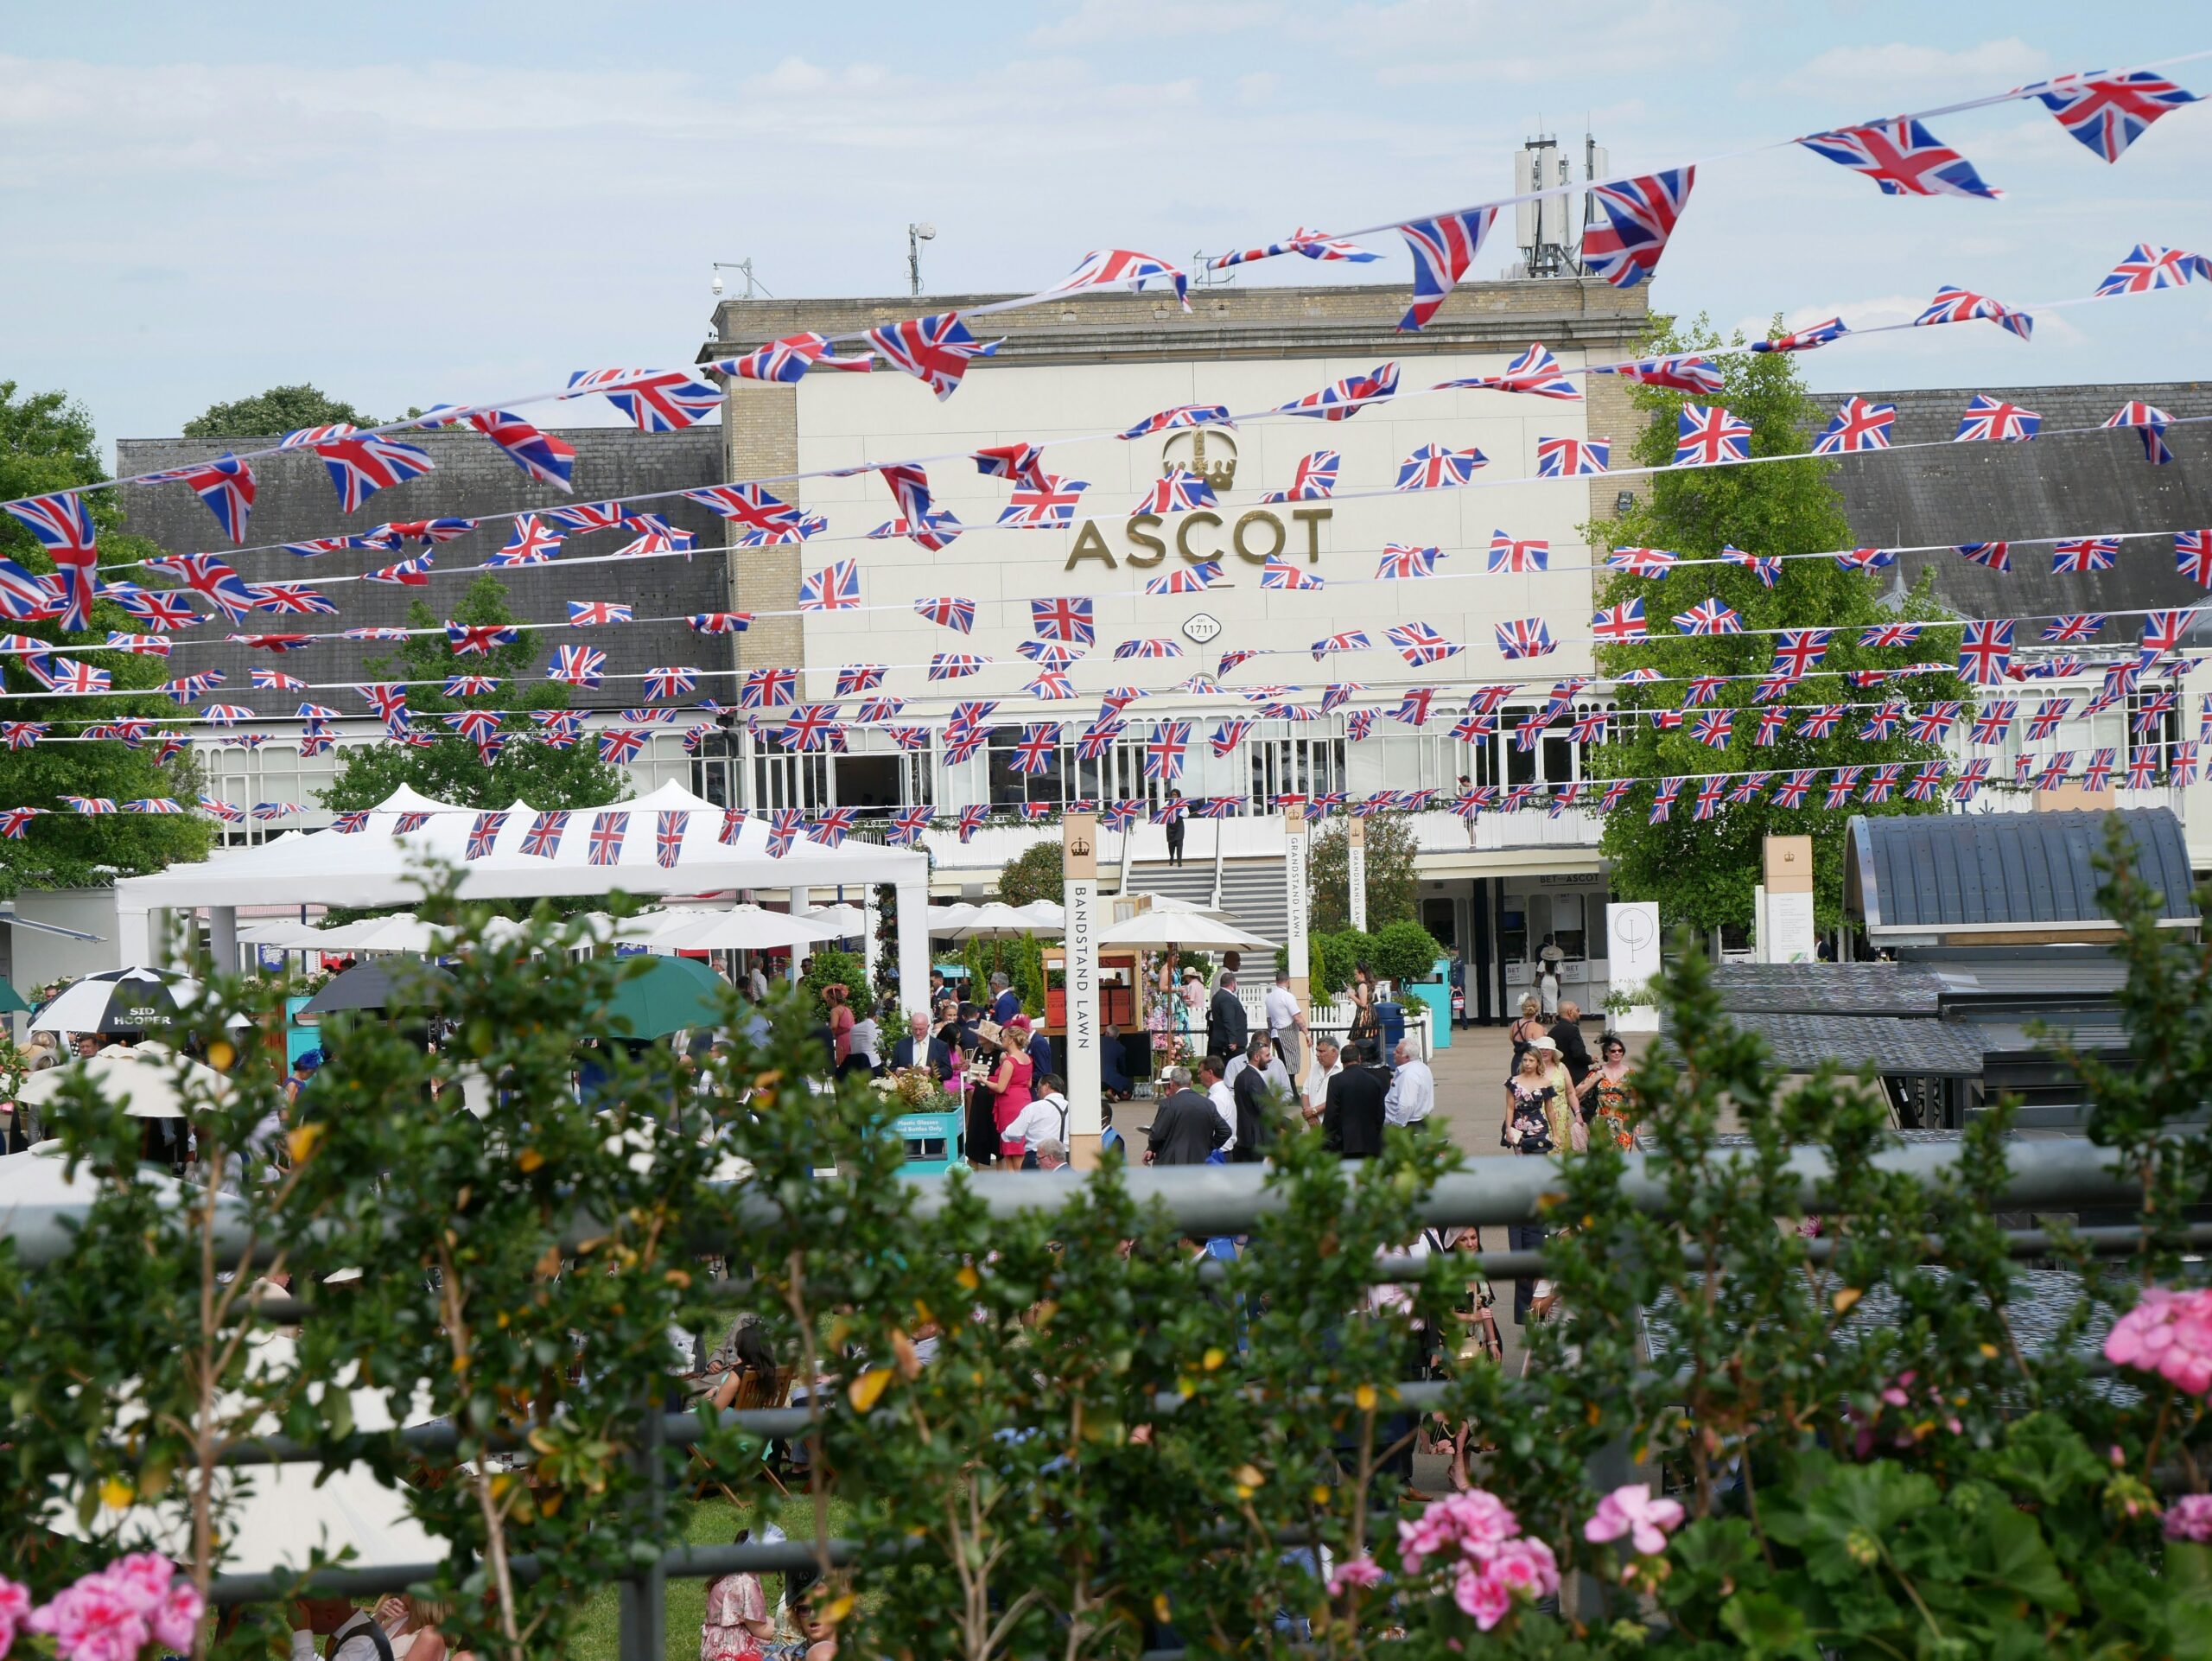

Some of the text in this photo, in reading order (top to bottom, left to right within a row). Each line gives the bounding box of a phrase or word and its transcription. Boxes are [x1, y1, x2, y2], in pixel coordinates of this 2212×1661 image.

[1064, 508, 1333, 571] ASCOT
[1189, 624, 1213, 633] 1711
[1291, 837, 1300, 905] GRANDSTAND
[1566, 874, 1599, 882] ASCOT
[1075, 887, 1090, 1048] BANDSTAND LAWN
[130, 1007, 156, 1015] SID
[113, 1015, 172, 1025] HOOPER
